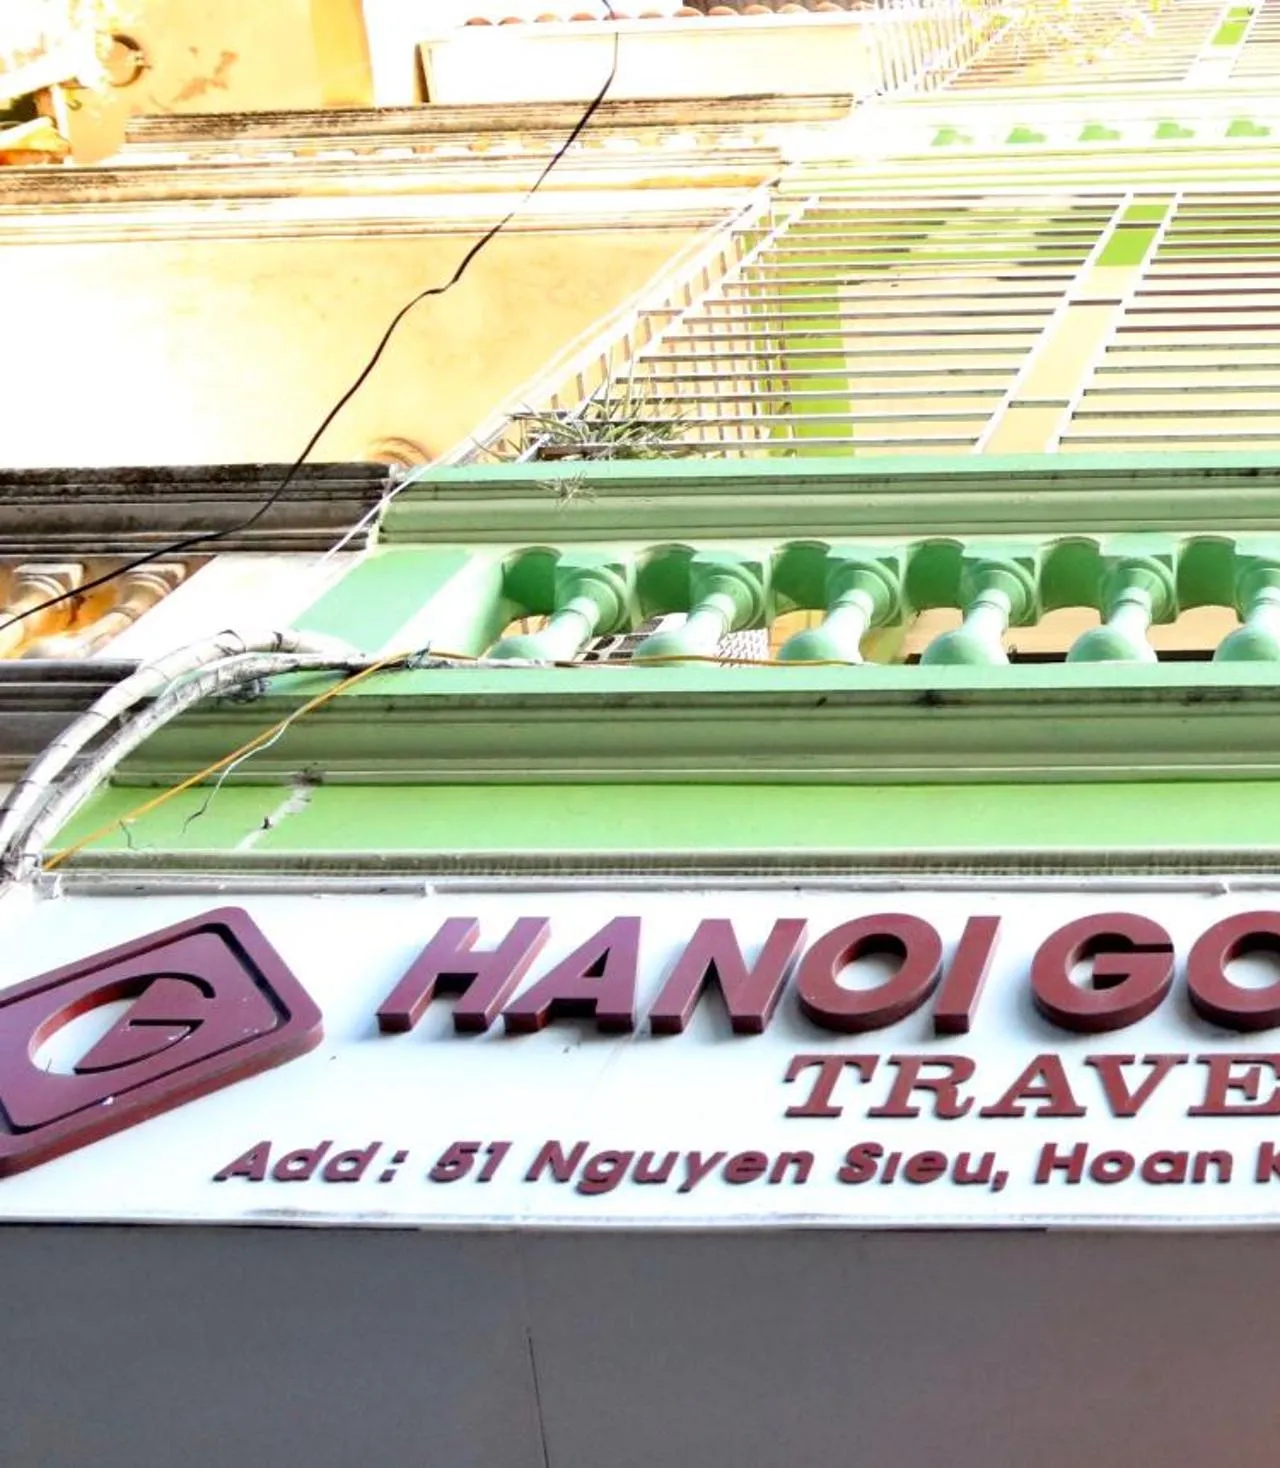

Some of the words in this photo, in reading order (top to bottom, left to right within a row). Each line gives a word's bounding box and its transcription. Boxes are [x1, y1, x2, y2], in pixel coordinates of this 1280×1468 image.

[376, 914, 1002, 1036] HANOI
[213, 1139, 409, 1184] Add:
[429, 1140, 512, 1184] 51
[527, 1140, 816, 1195] Nguyen
[1035, 1141, 1233, 1186] Hoan
